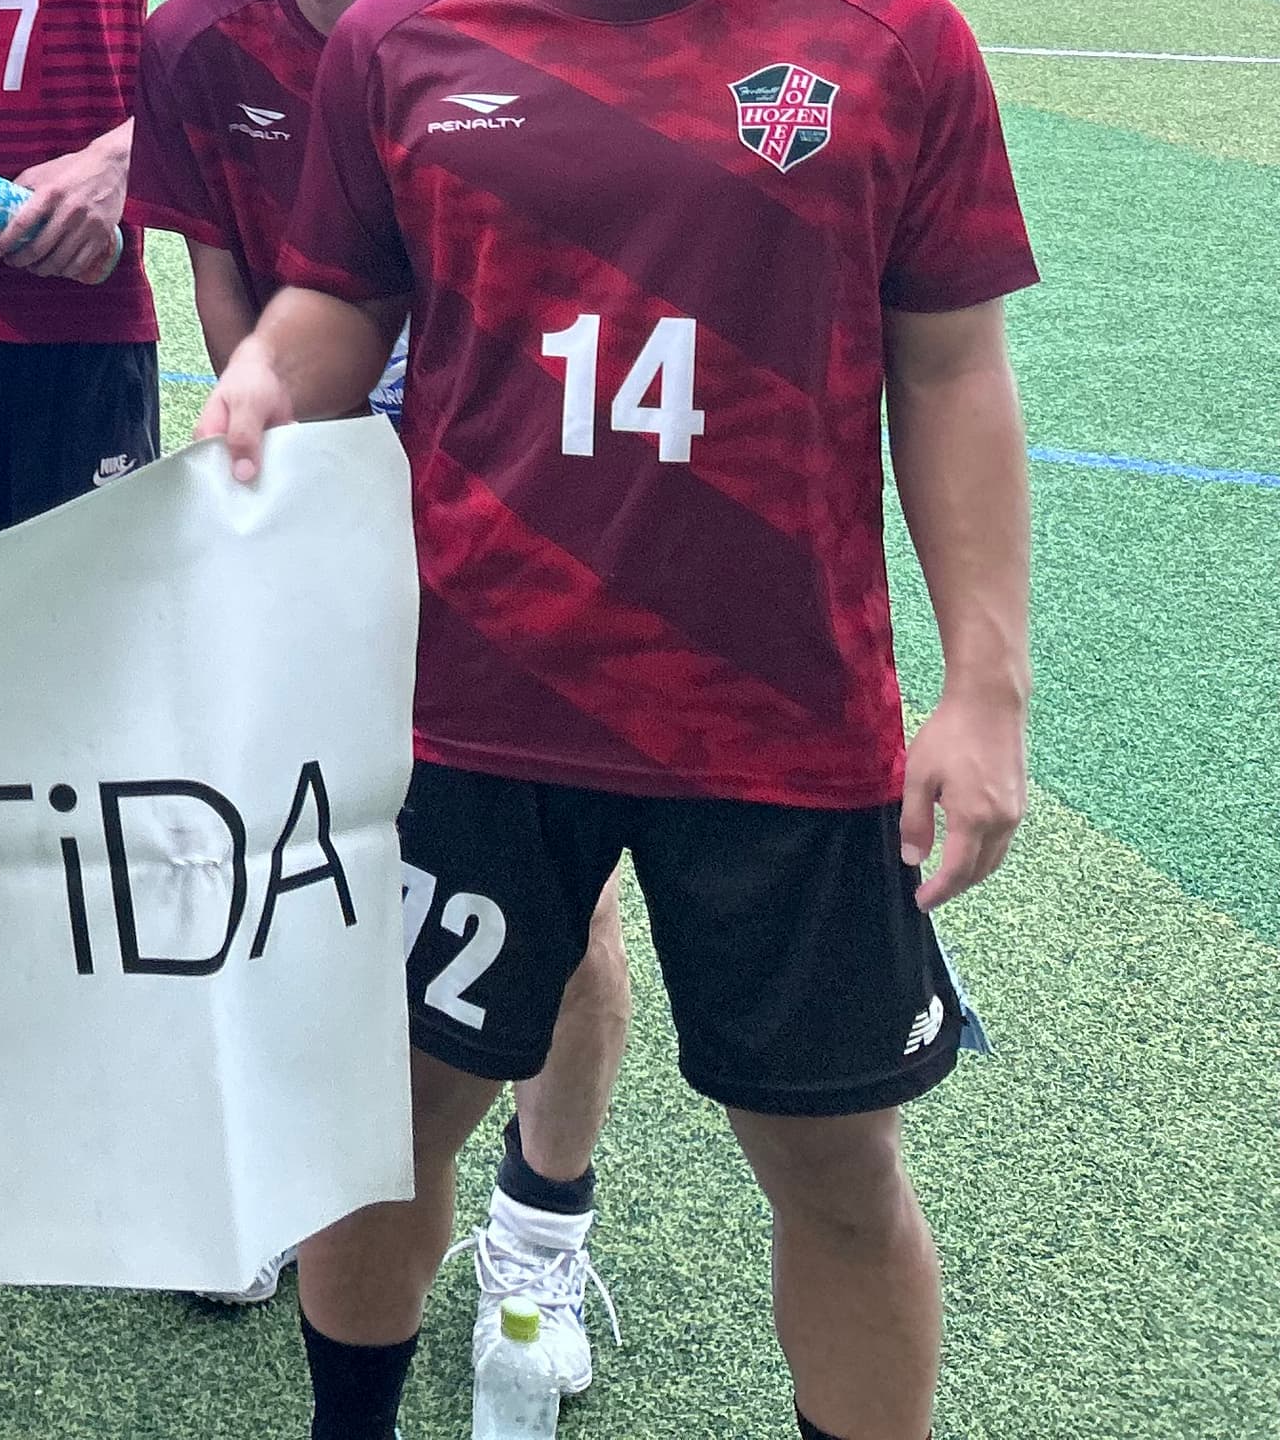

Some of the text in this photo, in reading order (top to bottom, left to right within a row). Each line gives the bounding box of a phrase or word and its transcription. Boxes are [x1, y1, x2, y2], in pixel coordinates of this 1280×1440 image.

[428, 116, 526, 133] PENALTY
[744, 108, 826, 124] HOZEN
[541, 314, 705, 463] 14
[100, 454, 128, 475] NIKE
